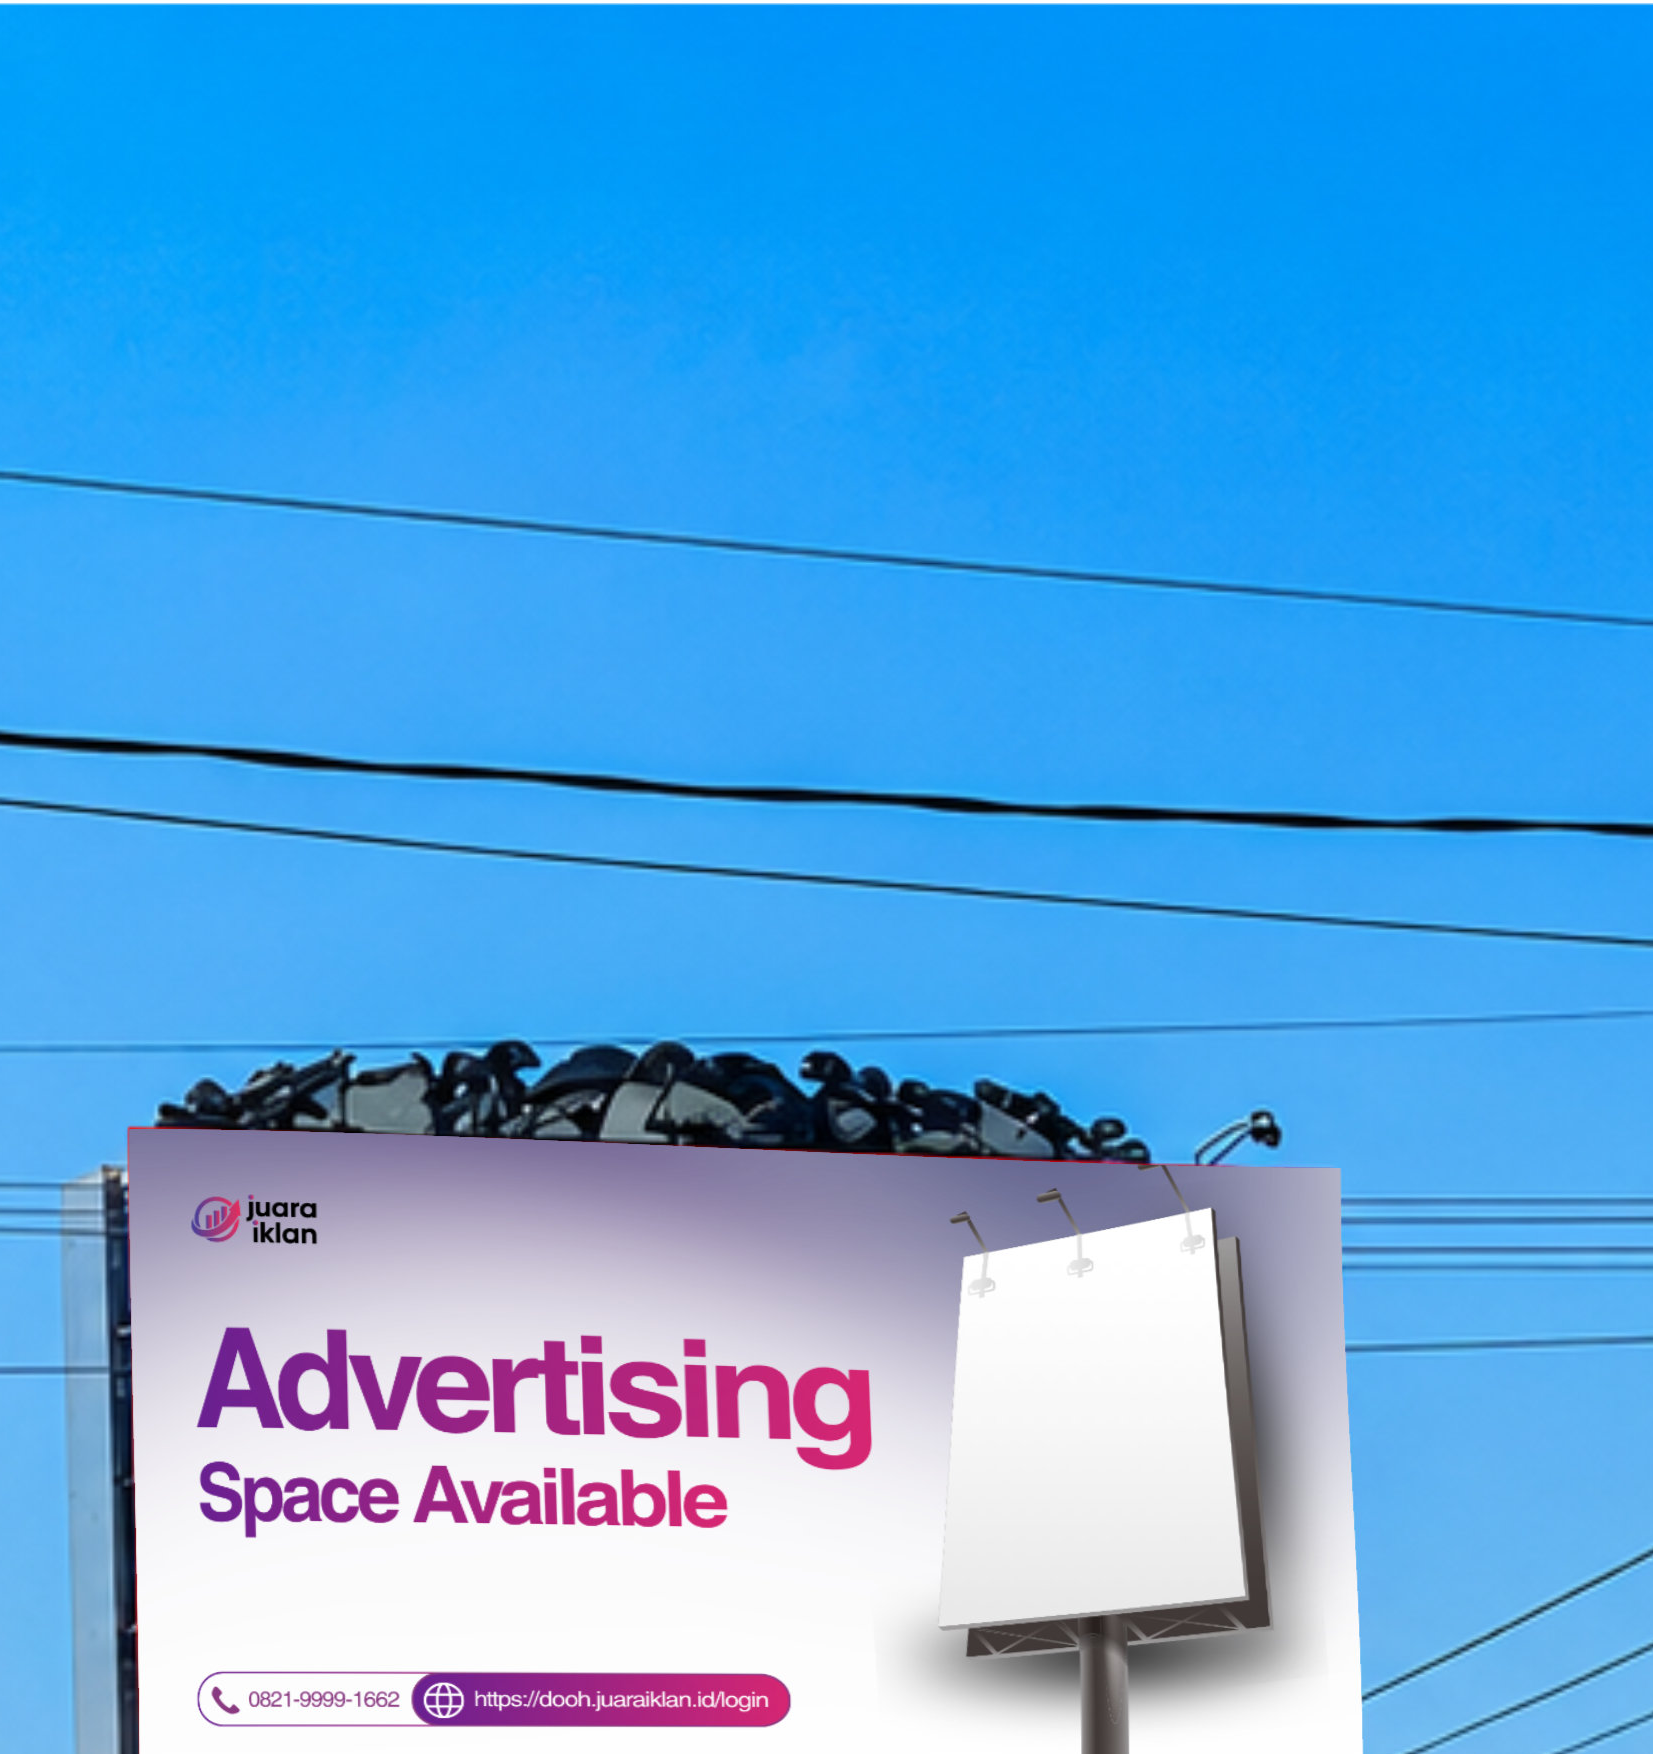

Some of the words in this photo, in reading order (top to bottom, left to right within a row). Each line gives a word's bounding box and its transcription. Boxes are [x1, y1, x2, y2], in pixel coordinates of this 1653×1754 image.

[246, 1194, 317, 1222] juara
[252, 1220, 317, 1244] iklan
[197, 1326, 873, 1471] Advertising
[199, 1461, 400, 1538] Space
[413, 1465, 729, 1529] Available
[248, 1690, 400, 1709] 0821-9999-1662
[474, 1689, 769, 1712] https://dooh.juaraiklan.id/login
